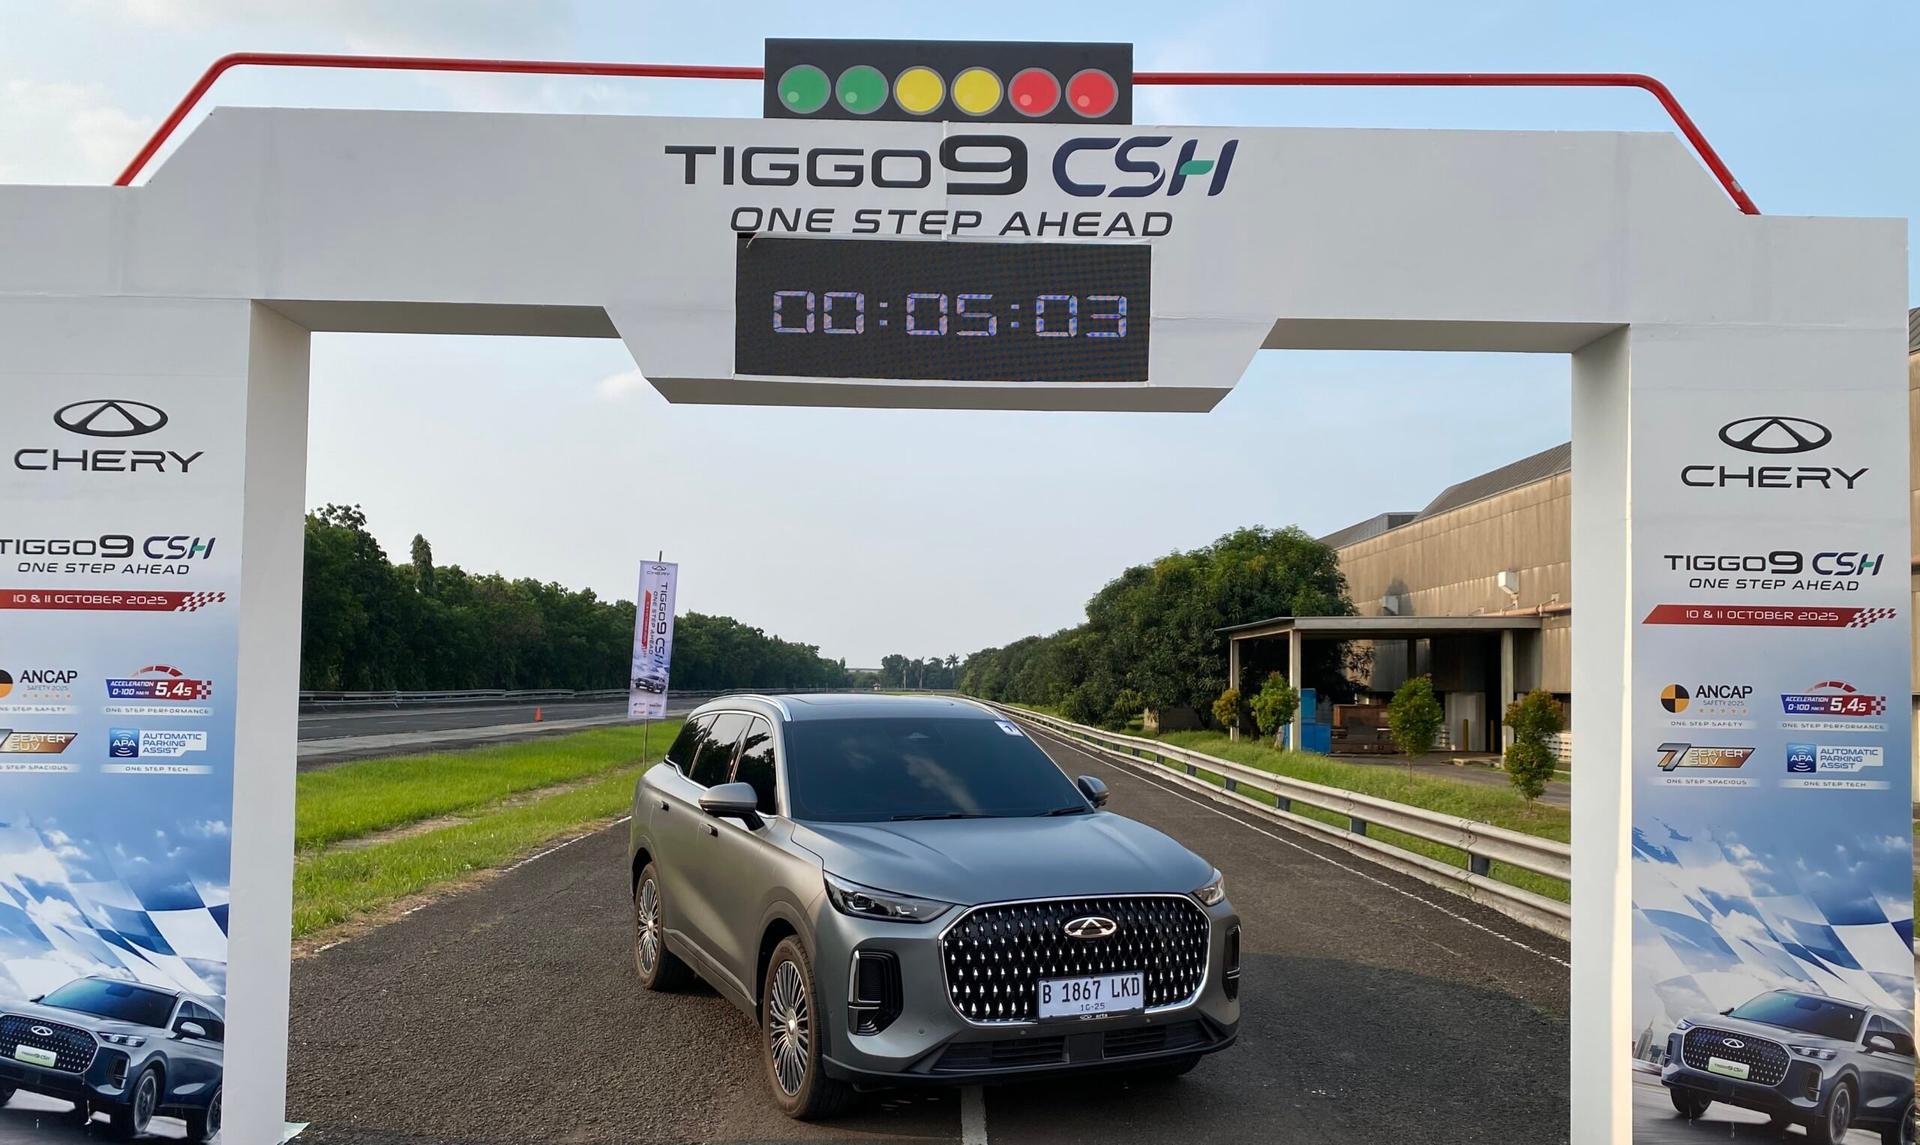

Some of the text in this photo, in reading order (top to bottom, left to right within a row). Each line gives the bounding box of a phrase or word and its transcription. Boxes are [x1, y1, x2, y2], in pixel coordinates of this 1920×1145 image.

[1052, 136, 1239, 197] CSH
[730, 207, 1173, 237] ONE STEP AHEAD
[773, 290, 1127, 338] 00:05:03
[14, 449, 204, 473] CHERY
[1681, 465, 1870, 490] CHERY
[143, 536, 216, 560] CSH
[18, 562, 190, 575] ONE STEP AHEAD
[1812, 552, 1884, 576] CSH
[1689, 578, 1859, 591] ONE STEP AHEAD
[13, 594, 168, 605] 10 & 11 OCTOBER 2025
[1686, 610, 1839, 621] 10 & 11 OCTOBER 2025
[20, 670, 78, 683] ANCAP
[1696, 685, 1753, 699] ANCAP
[12, 734, 66, 743] SEATER
[12, 743, 40, 751] SUV
[1690, 749, 1743, 758] SEATER
[1820, 748, 1879, 756] AUTOMATIC
[1690, 757, 1719, 765] SUV
[1043, 977, 1140, 1004] B 1867 LKD
